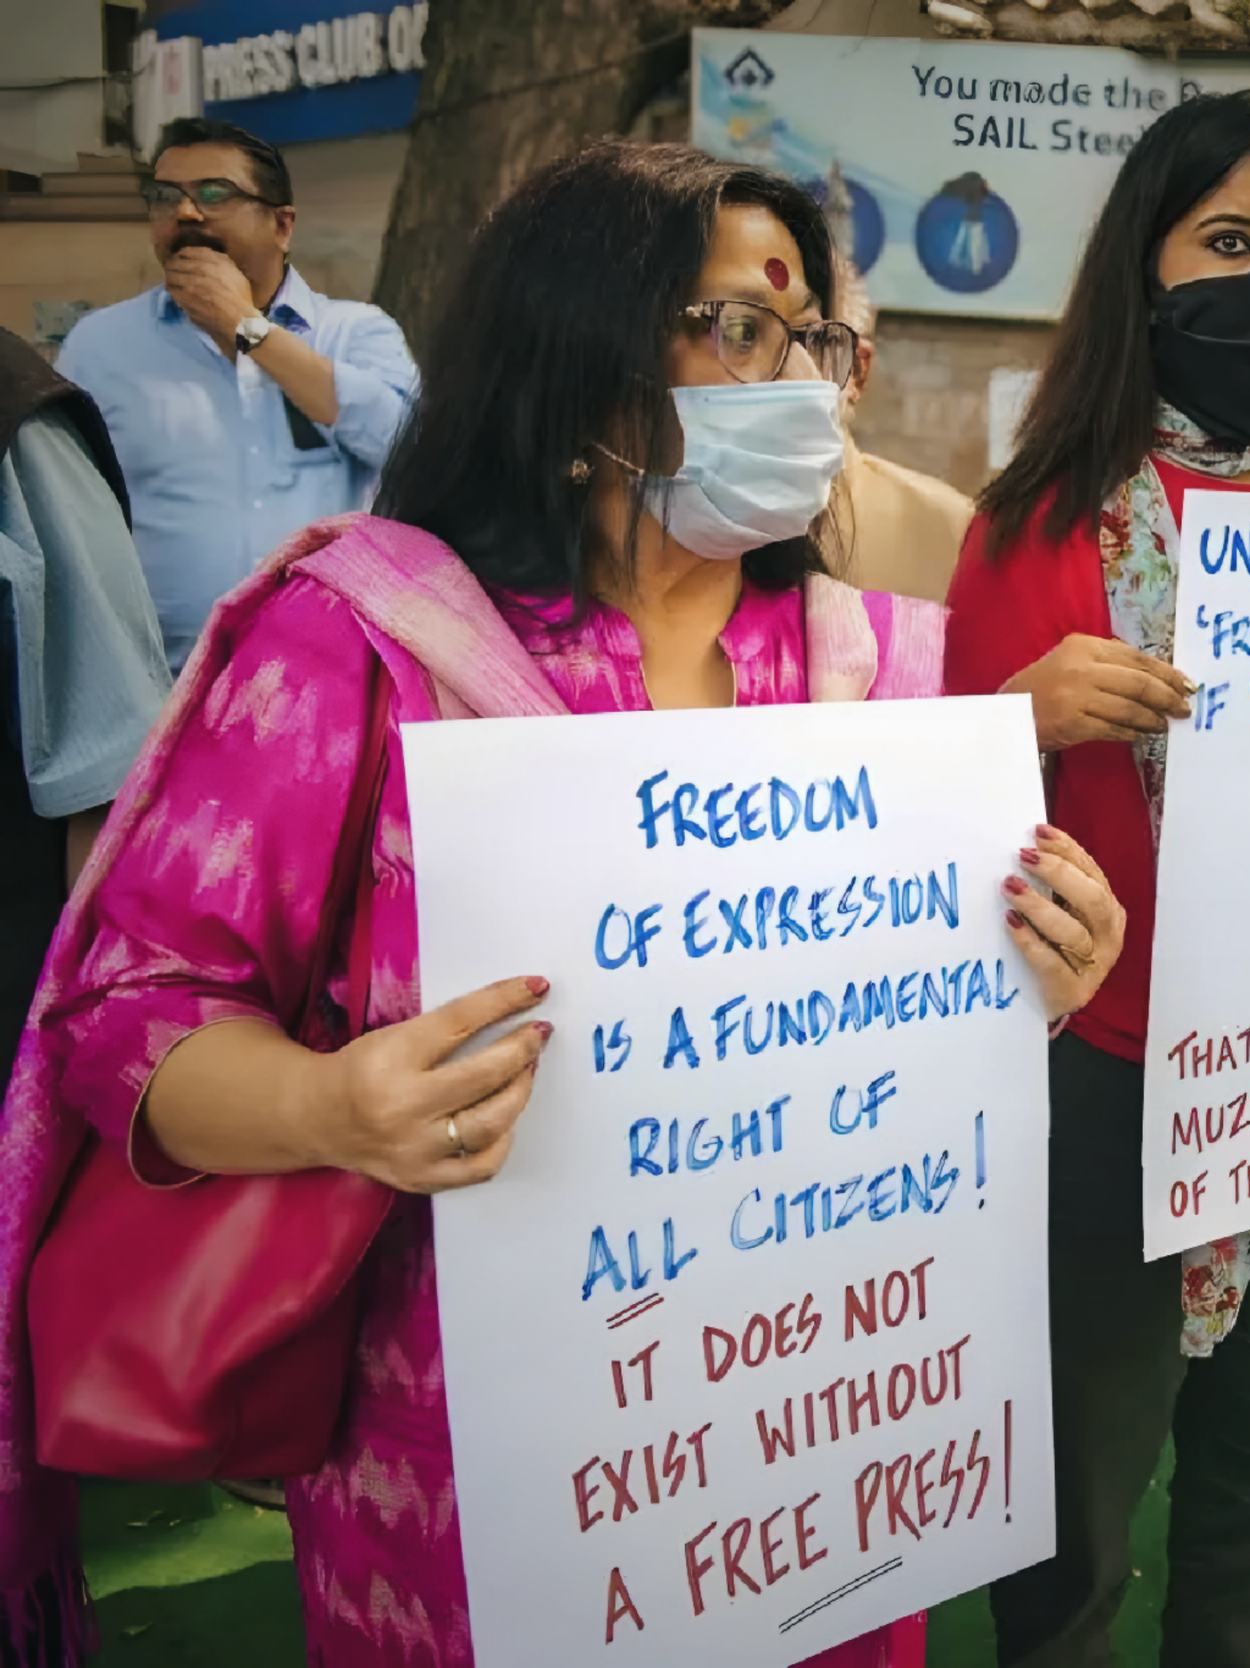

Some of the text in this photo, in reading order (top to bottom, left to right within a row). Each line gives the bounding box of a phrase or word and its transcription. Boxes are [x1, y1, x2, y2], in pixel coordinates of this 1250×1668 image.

[296, 12, 384, 87] CLUB
[911, 64, 978, 101] You
[989, 73, 1093, 107] made
[1103, 75, 1168, 113] the
[953, 113, 1145, 156] SAIL Stee
[1194, 682, 1230, 732] IF
[636, 765, 878, 849] FREEDOM
[595, 862, 959, 969] OF EXPRESSION
[592, 959, 1019, 1073] IS A FUNDAMENTAL
[630, 1070, 896, 1176] RIGHT OF
[582, 1110, 986, 1301] ALL CITIZENS!
[1170, 1170, 1208, 1217] OF
[611, 1256, 935, 1408] IT DOES NOT
[571, 1334, 971, 1533] EXIST WITHOUT
[605, 1399, 1012, 1645] A FREE PRESS!
